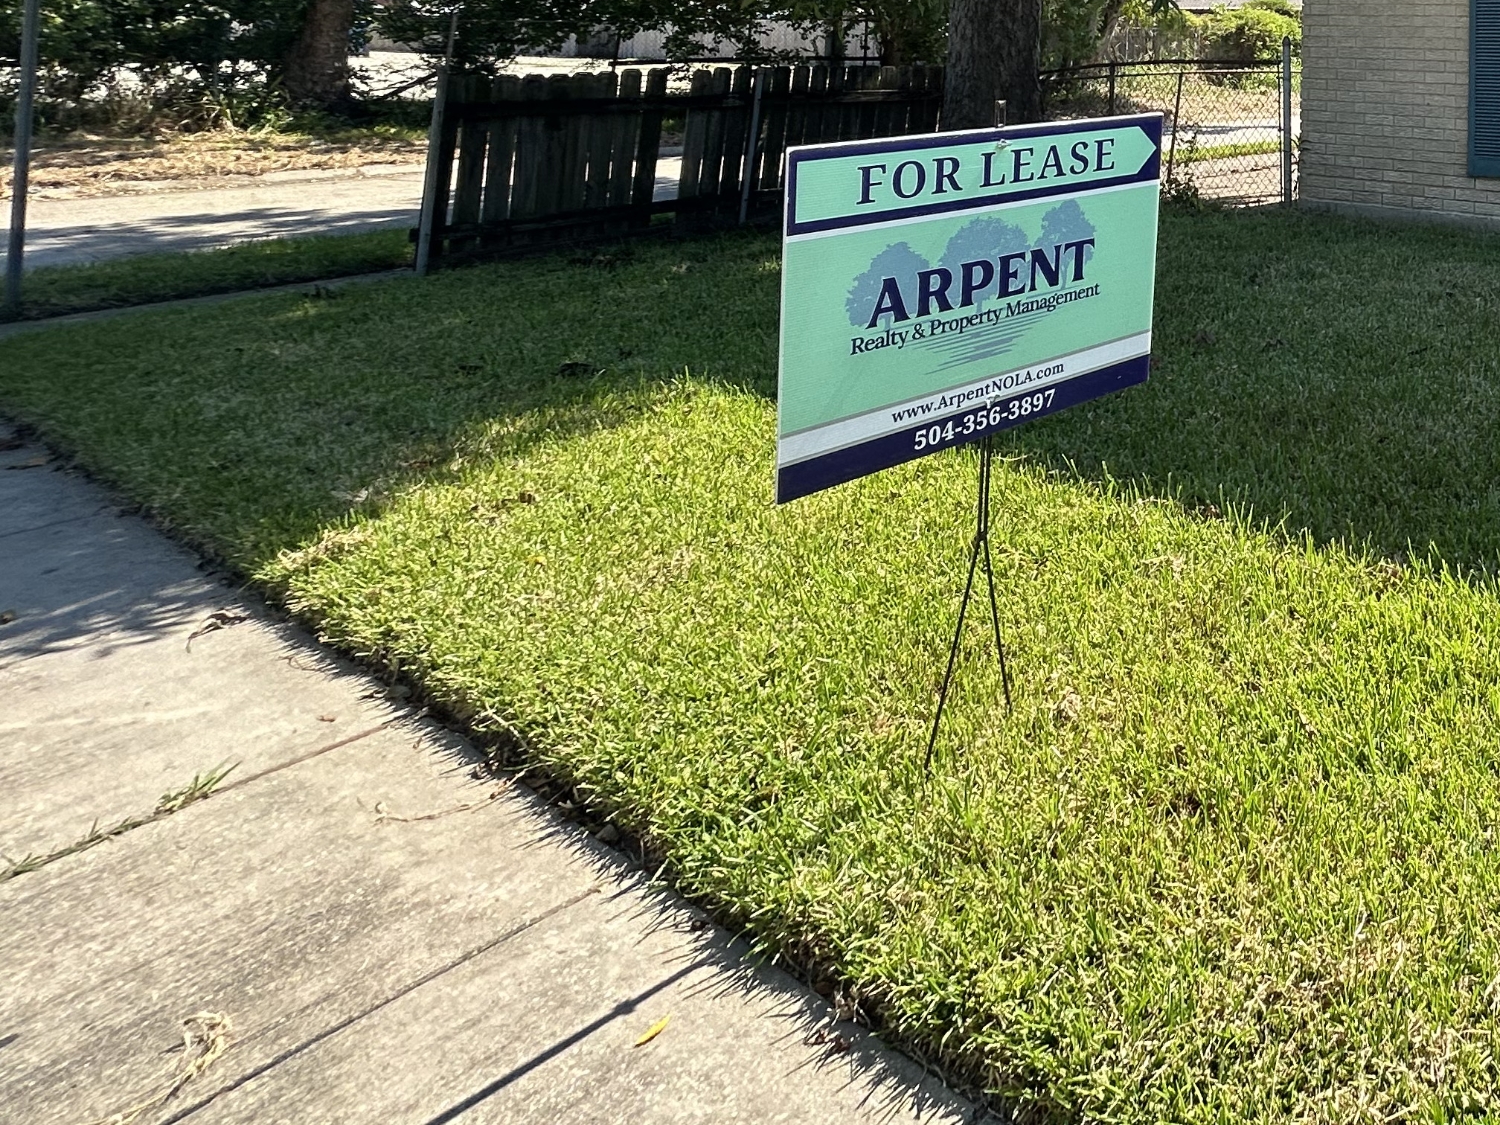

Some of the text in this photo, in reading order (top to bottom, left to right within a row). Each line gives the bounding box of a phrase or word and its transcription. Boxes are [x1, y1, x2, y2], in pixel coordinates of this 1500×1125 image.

[856, 138, 1115, 205] FOR LEASE
[865, 238, 1096, 330] ARPENT
[850, 283, 1101, 355] Realty & Property Management
[892, 363, 1065, 423] www.ArpentNOLA.com
[914, 389, 1056, 450] 504-356-3897
